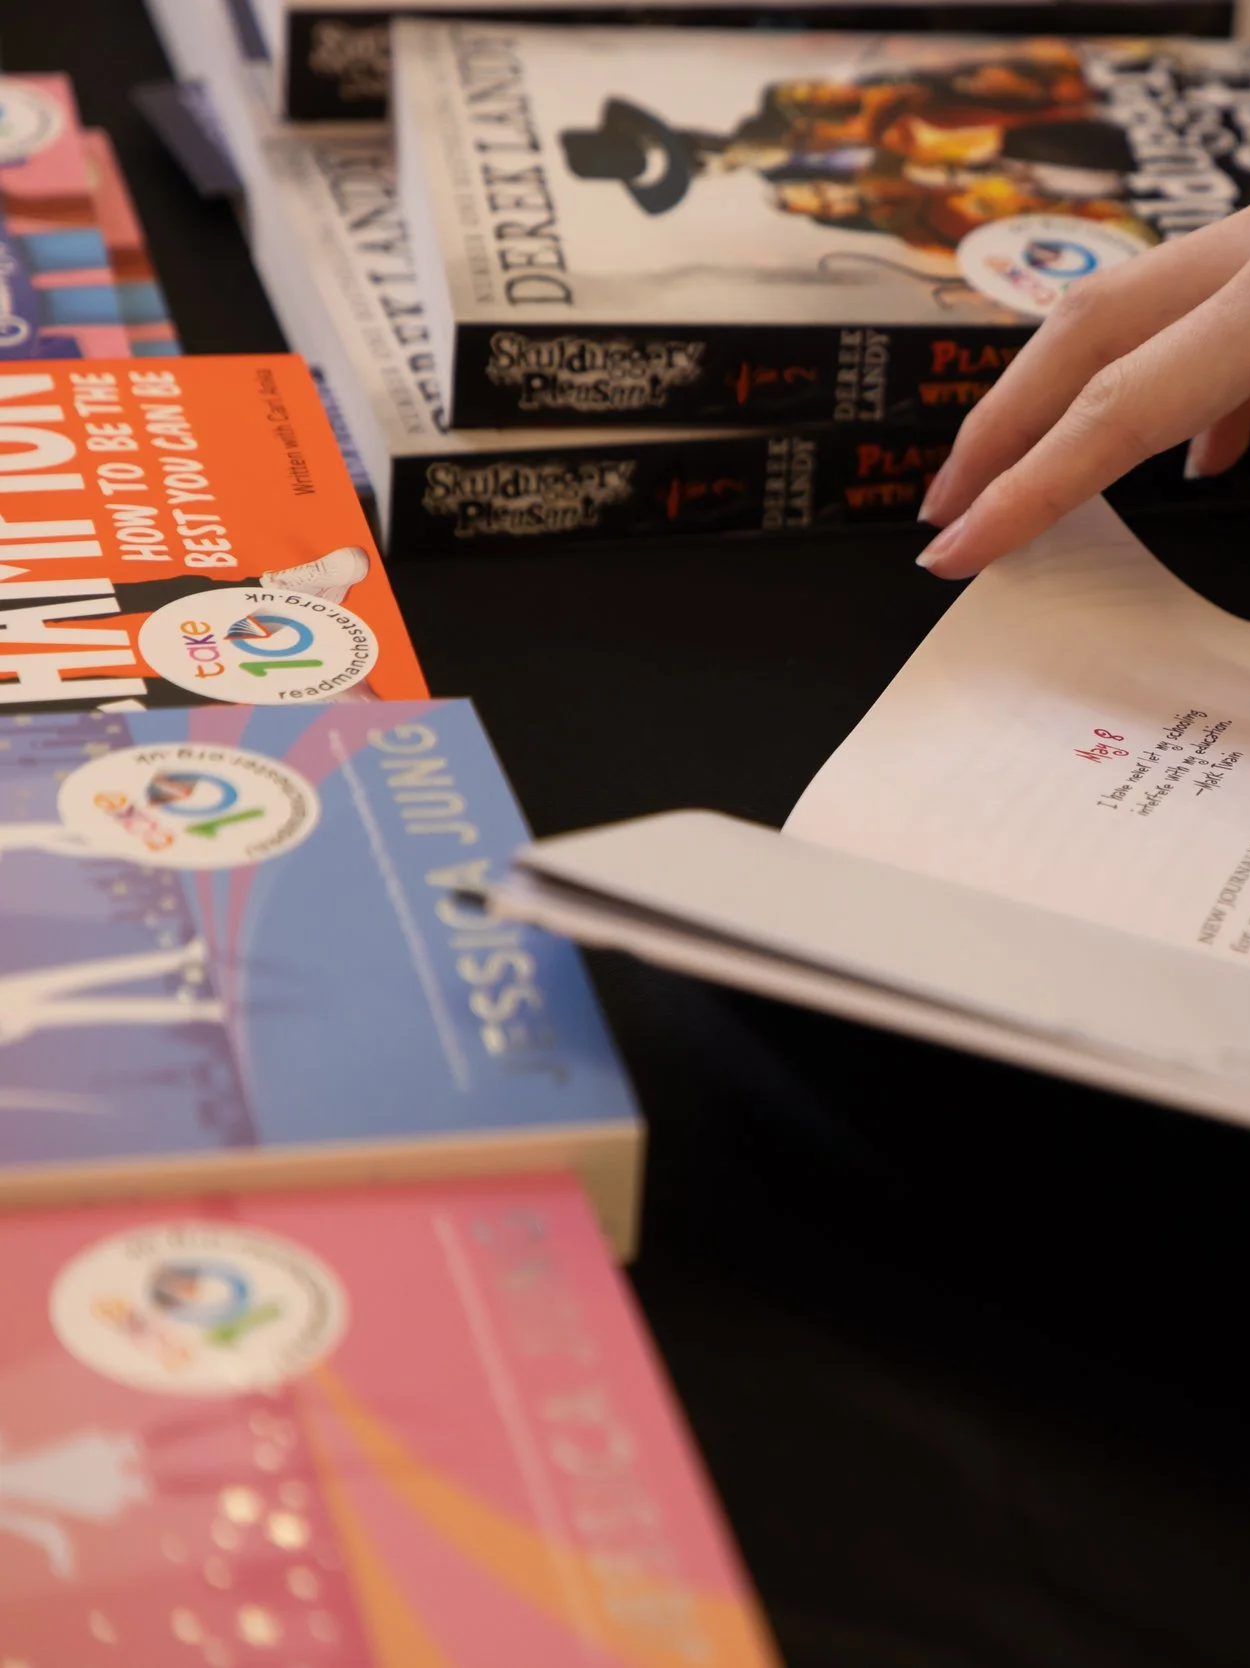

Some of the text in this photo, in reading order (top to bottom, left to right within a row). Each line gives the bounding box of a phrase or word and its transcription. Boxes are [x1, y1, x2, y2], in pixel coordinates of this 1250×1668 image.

[448, 24, 575, 306] DEREK LANDY
[489, 331, 706, 380] Skulduggery
[834, 328, 863, 421] DEREK
[858, 328, 891, 422] LANDY
[261, 398, 290, 421] Carl
[518, 372, 667, 411] Pleasant
[69, 371, 173, 562] HOW TO BE THE
[128, 370, 239, 568] BEST YOU CAN BE
[272, 424, 299, 450] with
[287, 451, 316, 496] Written
[424, 461, 637, 507] Skulduggery
[762, 437, 790, 531] DEREK
[786, 437, 816, 527] LANDY
[455, 497, 602, 537] Pleasant
[180, 620, 225, 679] take
[223, 613, 323, 677] 10
[245, 592, 369, 700] readmanchester.org.uk
[1073, 728, 1129, 763] May 8
[1096, 709, 1208, 810] I have never let my schooling
[1129, 720, 1233, 817] interfere with my education.
[1210, 751, 1245, 771] Twain
[367, 724, 570, 1086] JESSICA JUNG
[1197, 907, 1227, 946] NEW
